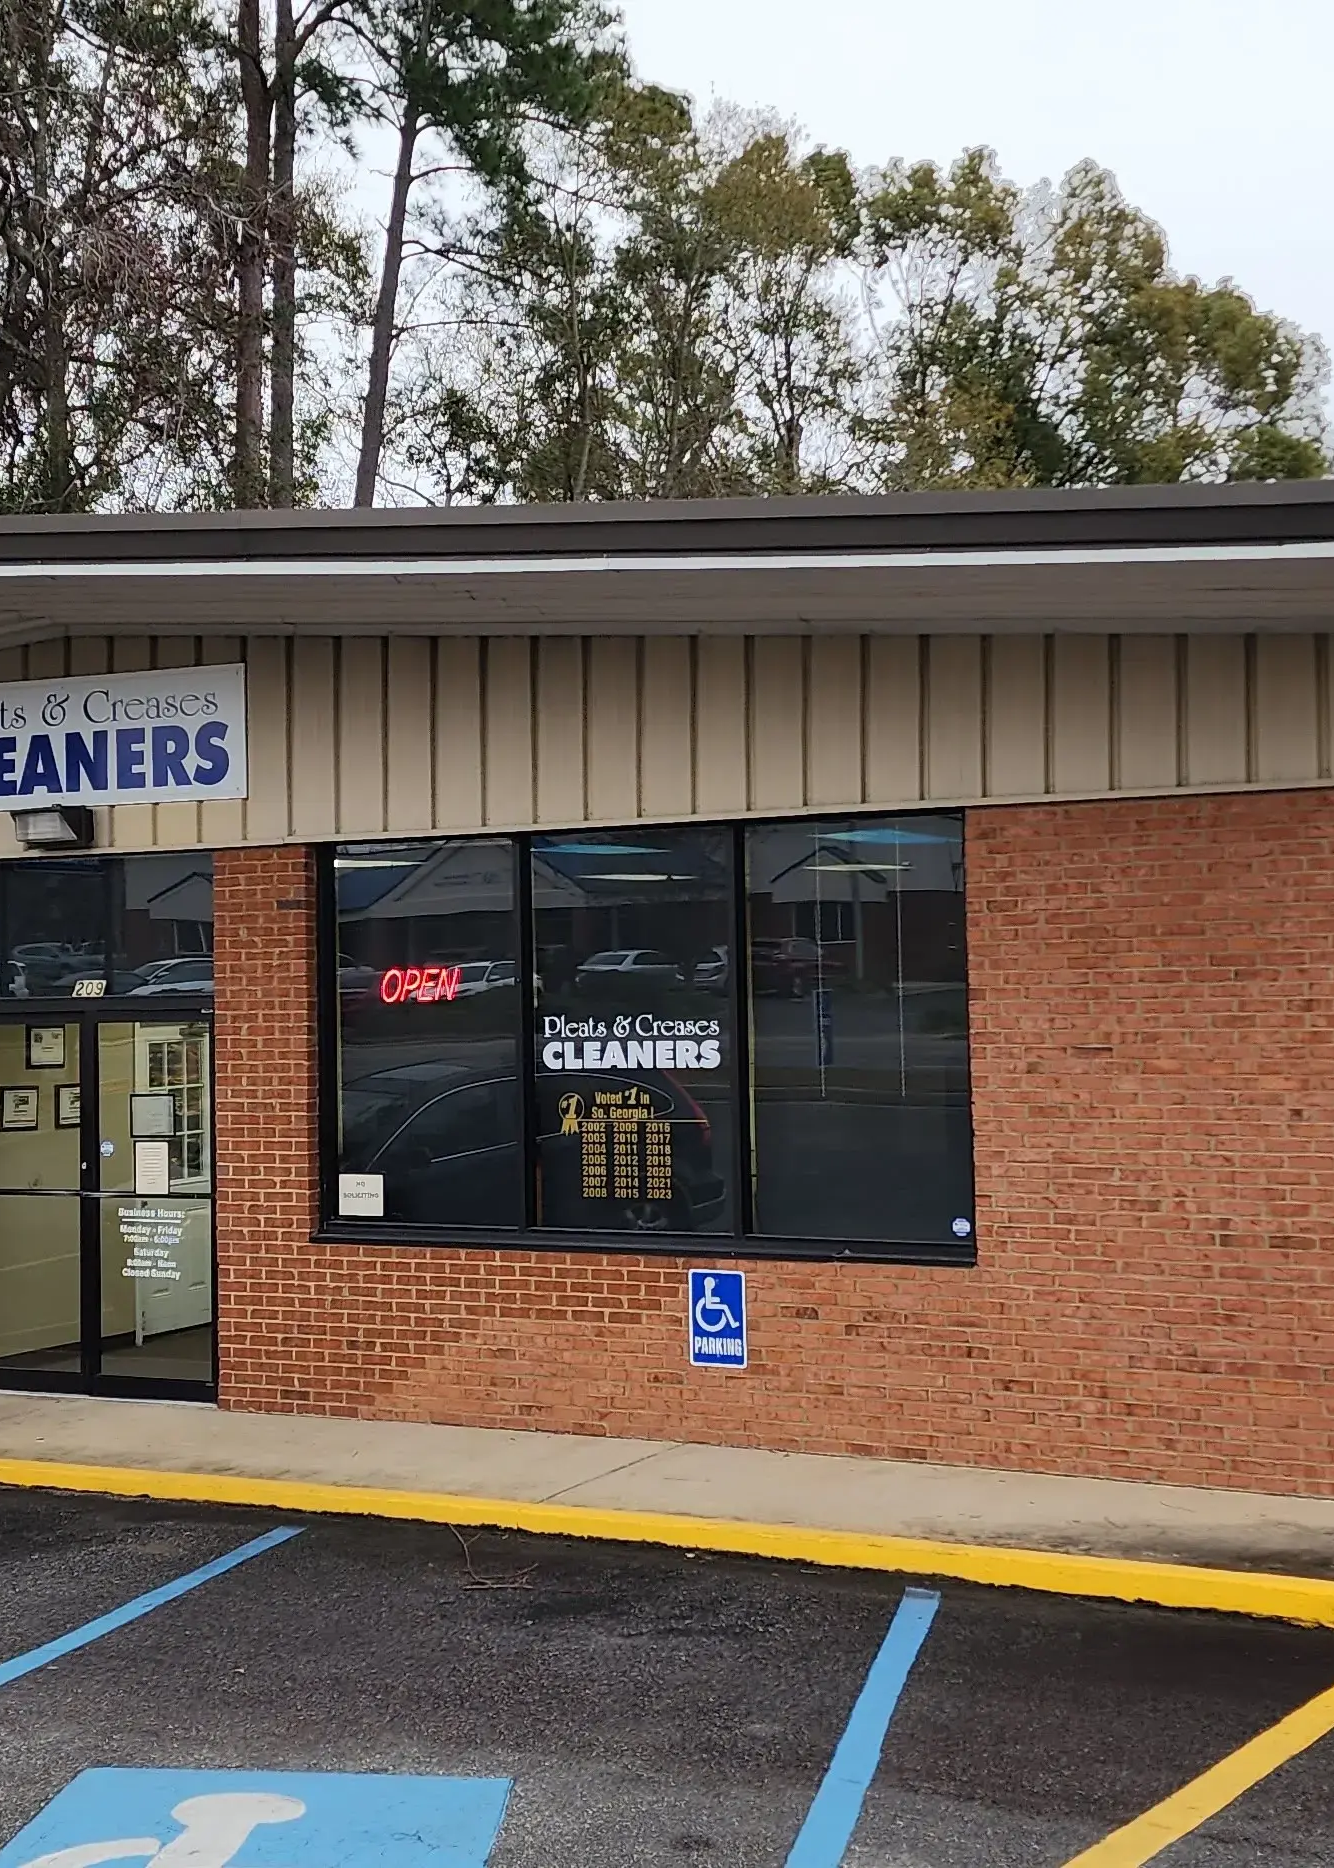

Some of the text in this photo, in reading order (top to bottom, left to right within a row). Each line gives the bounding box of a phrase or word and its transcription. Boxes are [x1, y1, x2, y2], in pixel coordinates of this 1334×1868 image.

[42, 693, 70, 727] &
[82, 689, 219, 724] Creases
[75, 981, 105, 996] 209
[381, 967, 461, 1003] OPEN
[543, 1014, 720, 1038] Pleats & Creases
[542, 1040, 721, 1070] CLEANERS
[594, 1091, 623, 1105] Voted
[640, 1091, 650, 1105] in
[591, 1106, 607, 1119] So.
[609, 1106, 648, 1120] Georgia
[582, 1123, 670, 1132] 2002 2009 2016
[582, 1133, 670, 1143] 2003 2010 2017
[582, 1144, 671, 1154] 2004 2011 2018
[582, 1155, 671, 1165] 2005 2012 2019
[582, 1166, 671, 1176] 2006 2013 2020
[583, 1177, 671, 1187] 2007 2014 2021
[583, 1188, 672, 1199] 2008 2015 2023
[118, 1207, 186, 1219] Business Hours:
[119, 1224, 152, 1235] Monday
[157, 1225, 183, 1236] Friday
[133, 1247, 169, 1259] Saturday
[122, 1268, 182, 1280] Closed Sunday
[694, 1336, 743, 1357] PARKING
